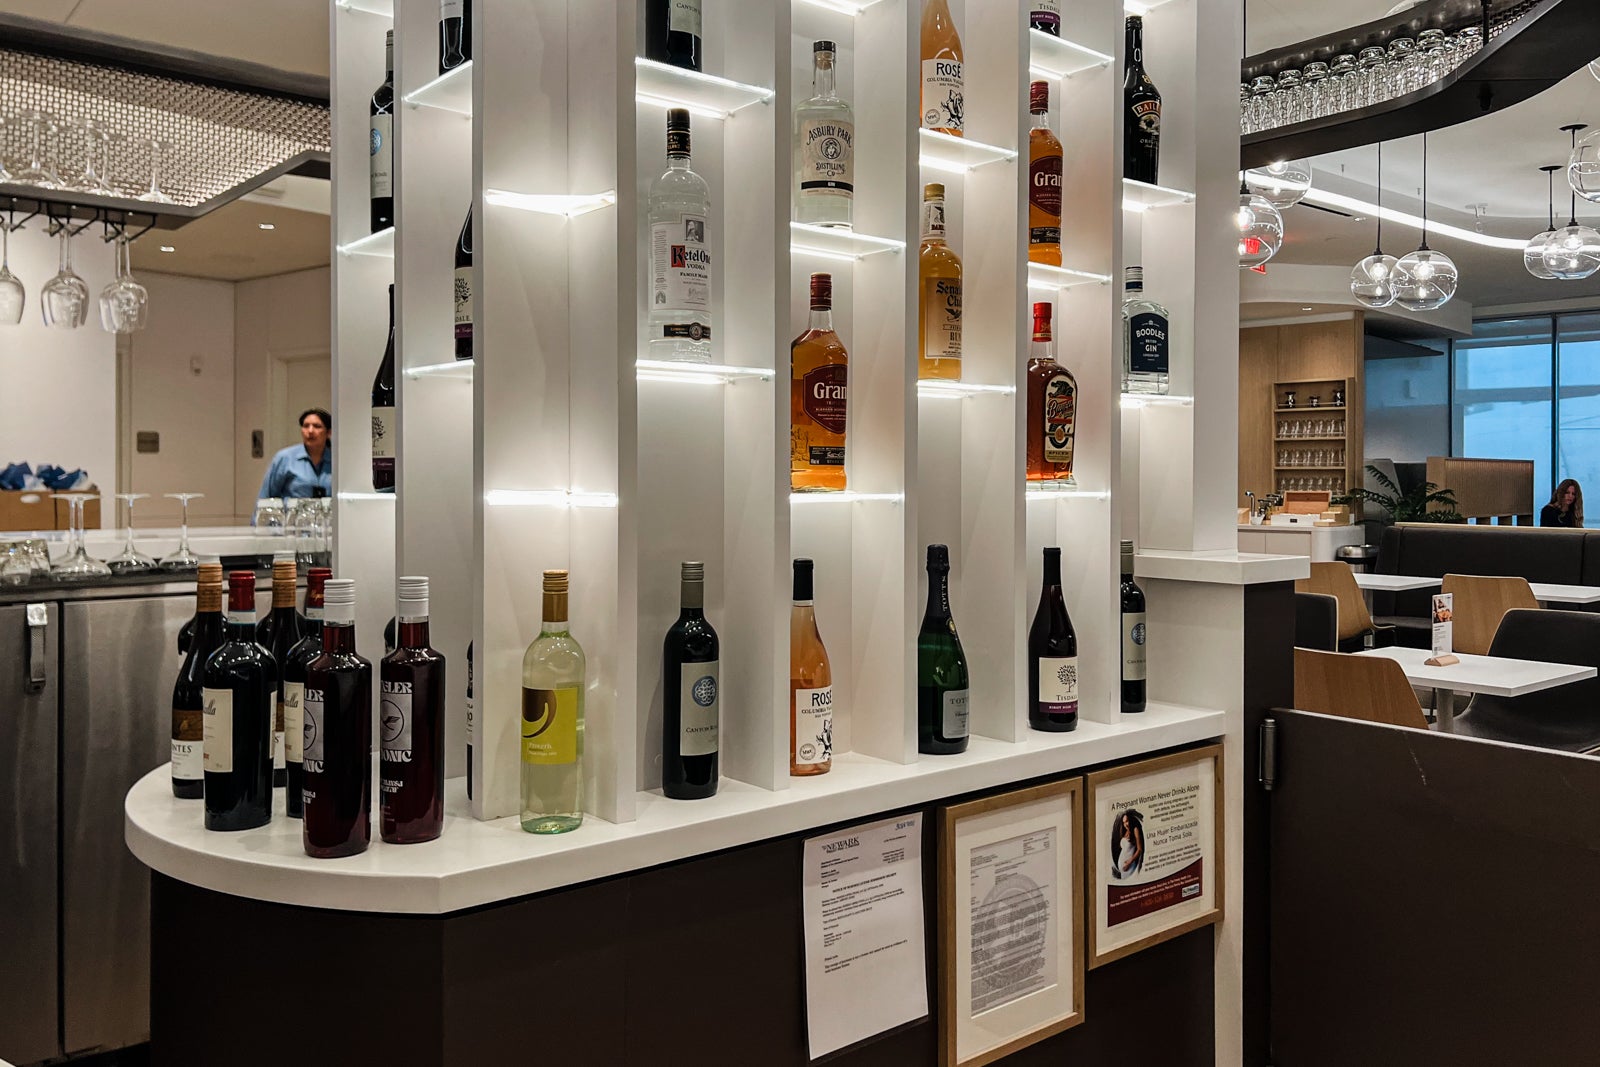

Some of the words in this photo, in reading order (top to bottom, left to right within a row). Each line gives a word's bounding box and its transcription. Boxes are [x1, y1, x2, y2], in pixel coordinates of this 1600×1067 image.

[806, 125, 836, 146] ASBURY
[837, 127, 852, 148] PARK
[672, 246, 699, 267] Ketel
[1136, 327, 1165, 340] BOODLES
[1145, 344, 1157, 352] GIN
[1116, 798, 1139, 810] Pregnant
[1138, 795, 1157, 805] Woman
[1157, 791, 1171, 800] Never
[1171, 786, 1186, 796] Drinks
[1186, 784, 1200, 792] Alone
[826, 836, 860, 850] NEWARK
[1169, 833, 1182, 842] Toma
